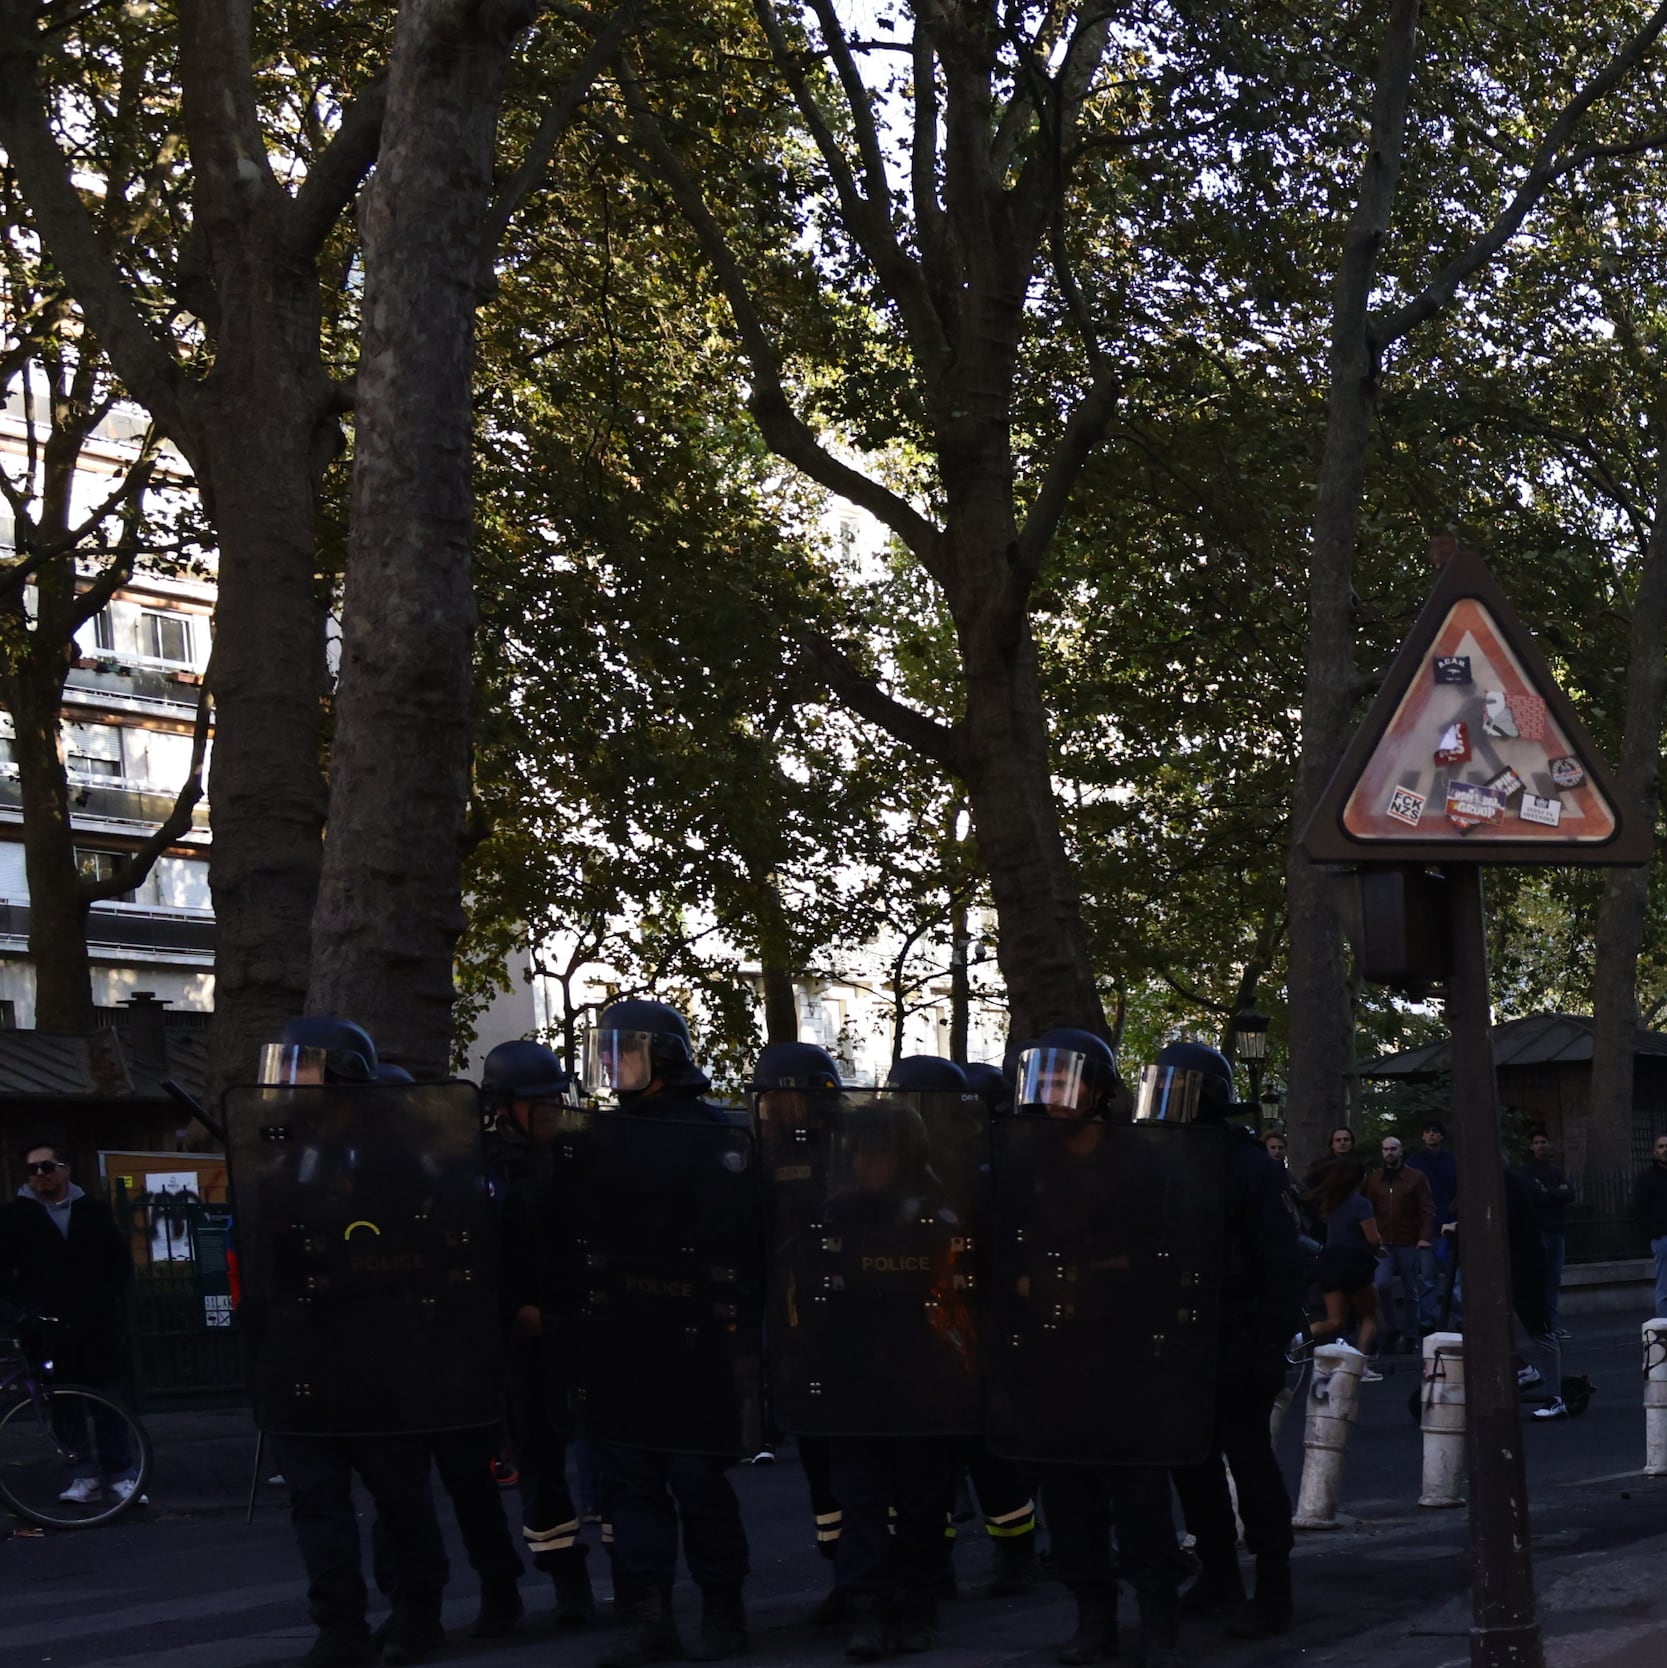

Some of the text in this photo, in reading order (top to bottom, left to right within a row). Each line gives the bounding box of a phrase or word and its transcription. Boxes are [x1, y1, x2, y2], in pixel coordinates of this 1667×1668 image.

[1390, 801, 1420, 820] NZS
[1394, 791, 1423, 811] FCK
[351, 1253, 426, 1272] POLICE
[862, 1255, 932, 1272] POLICE
[624, 1276, 696, 1298] POLICE
